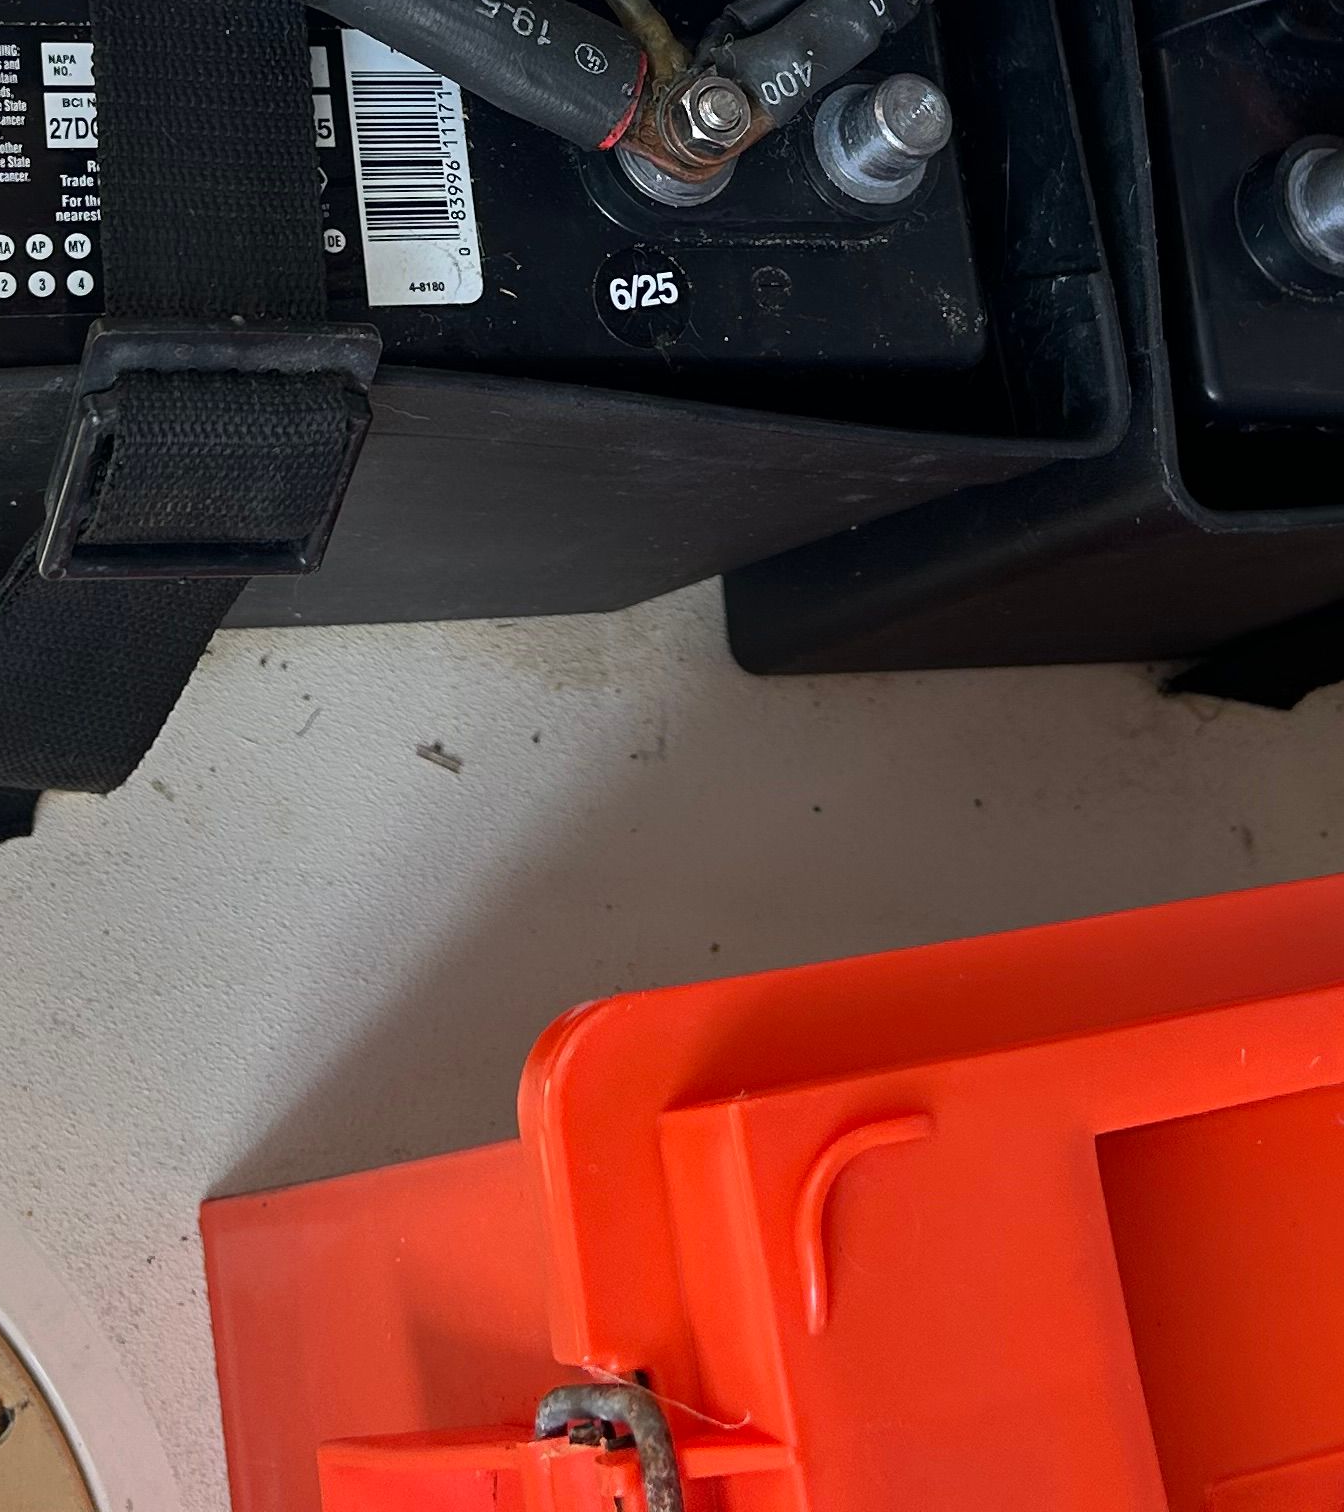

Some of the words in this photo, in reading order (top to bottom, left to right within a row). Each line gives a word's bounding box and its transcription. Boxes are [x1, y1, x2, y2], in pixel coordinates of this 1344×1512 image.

[3, 58, 20, 70] and
[48, 54, 76, 65] NAPA
[54, 66, 72, 77] NO.
[3, 100, 27, 112] State
[62, 98, 84, 108] BCI
[436, 89, 458, 148] 11171
[0, 143, 23, 155] other
[7, 156, 31, 168] State
[0, 171, 31, 183] cancer.
[59, 174, 94, 187] Trade
[445, 159, 467, 222] 83996
[61, 195, 82, 207] For
[31, 242, 46, 254] AP
[68, 240, 86, 253] MY
[327, 235, 342, 248] DE
[1, 279, 8, 292] 2
[39, 278, 46, 291] 3
[78, 277, 85, 289] 4
[408, 282, 445, 292] 4-8180
[609, 271, 679, 311] 6/25
